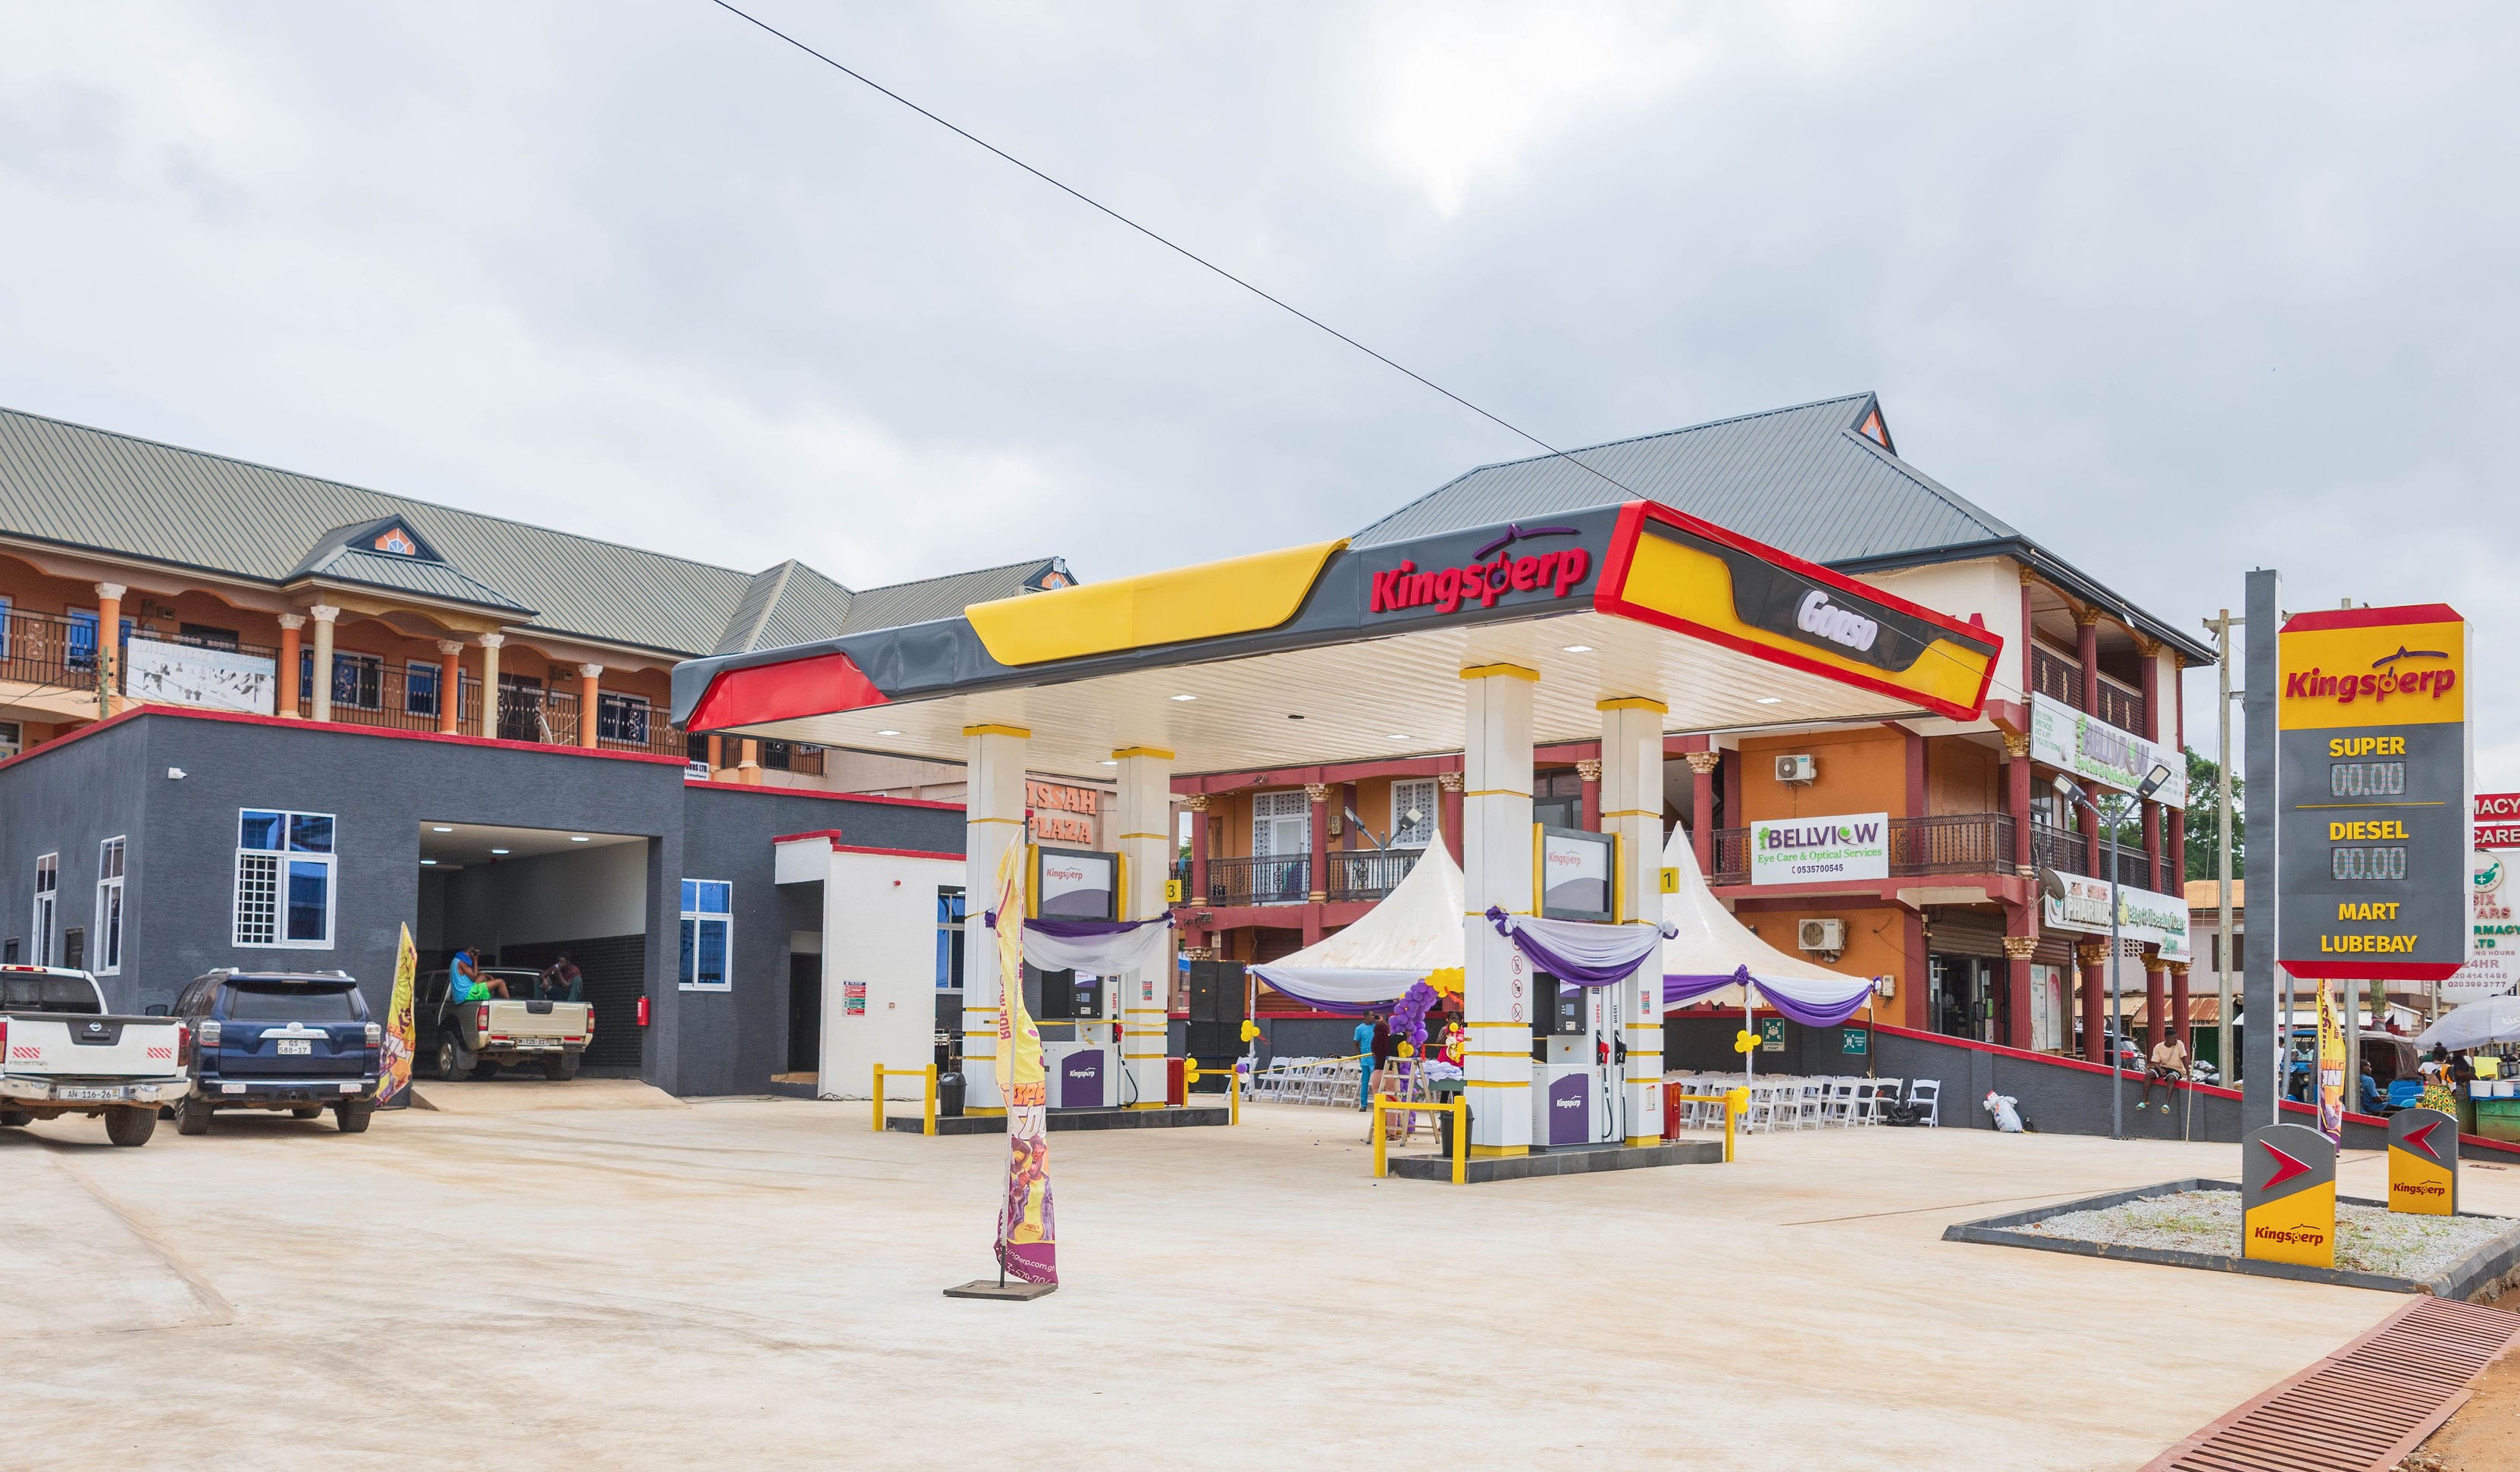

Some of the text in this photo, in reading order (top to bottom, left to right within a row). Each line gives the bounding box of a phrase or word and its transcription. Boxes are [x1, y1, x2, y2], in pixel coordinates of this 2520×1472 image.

[1369, 546, 1590, 614] Kingsperp
[2285, 667, 2456, 704] Kingsperp
[2329, 736, 2406, 758] SUPER
[2331, 762, 2403, 796] 00.00
[1028, 817, 1091, 844] PLAZA
[2330, 820, 2409, 841] DIESEL
[1548, 852, 1581, 868] Kingsperp
[1757, 847, 1882, 865] Eye Care & Optical Services
[2333, 847, 2406, 880] 00.00
[1046, 868, 1083, 881] Kingsperp
[1797, 864, 1844, 874] 0535700545
[1663, 872, 1671, 888] 1
[1168, 884, 1175, 898] 3
[2338, 902, 2400, 921] MART
[2321, 934, 2418, 953] LUBEBAY
[81, 1091, 111, 1099] 116-26
[2393, 1182, 2445, 1197] Kingsperp
[2255, 1226, 2324, 1246] Kingsperp
